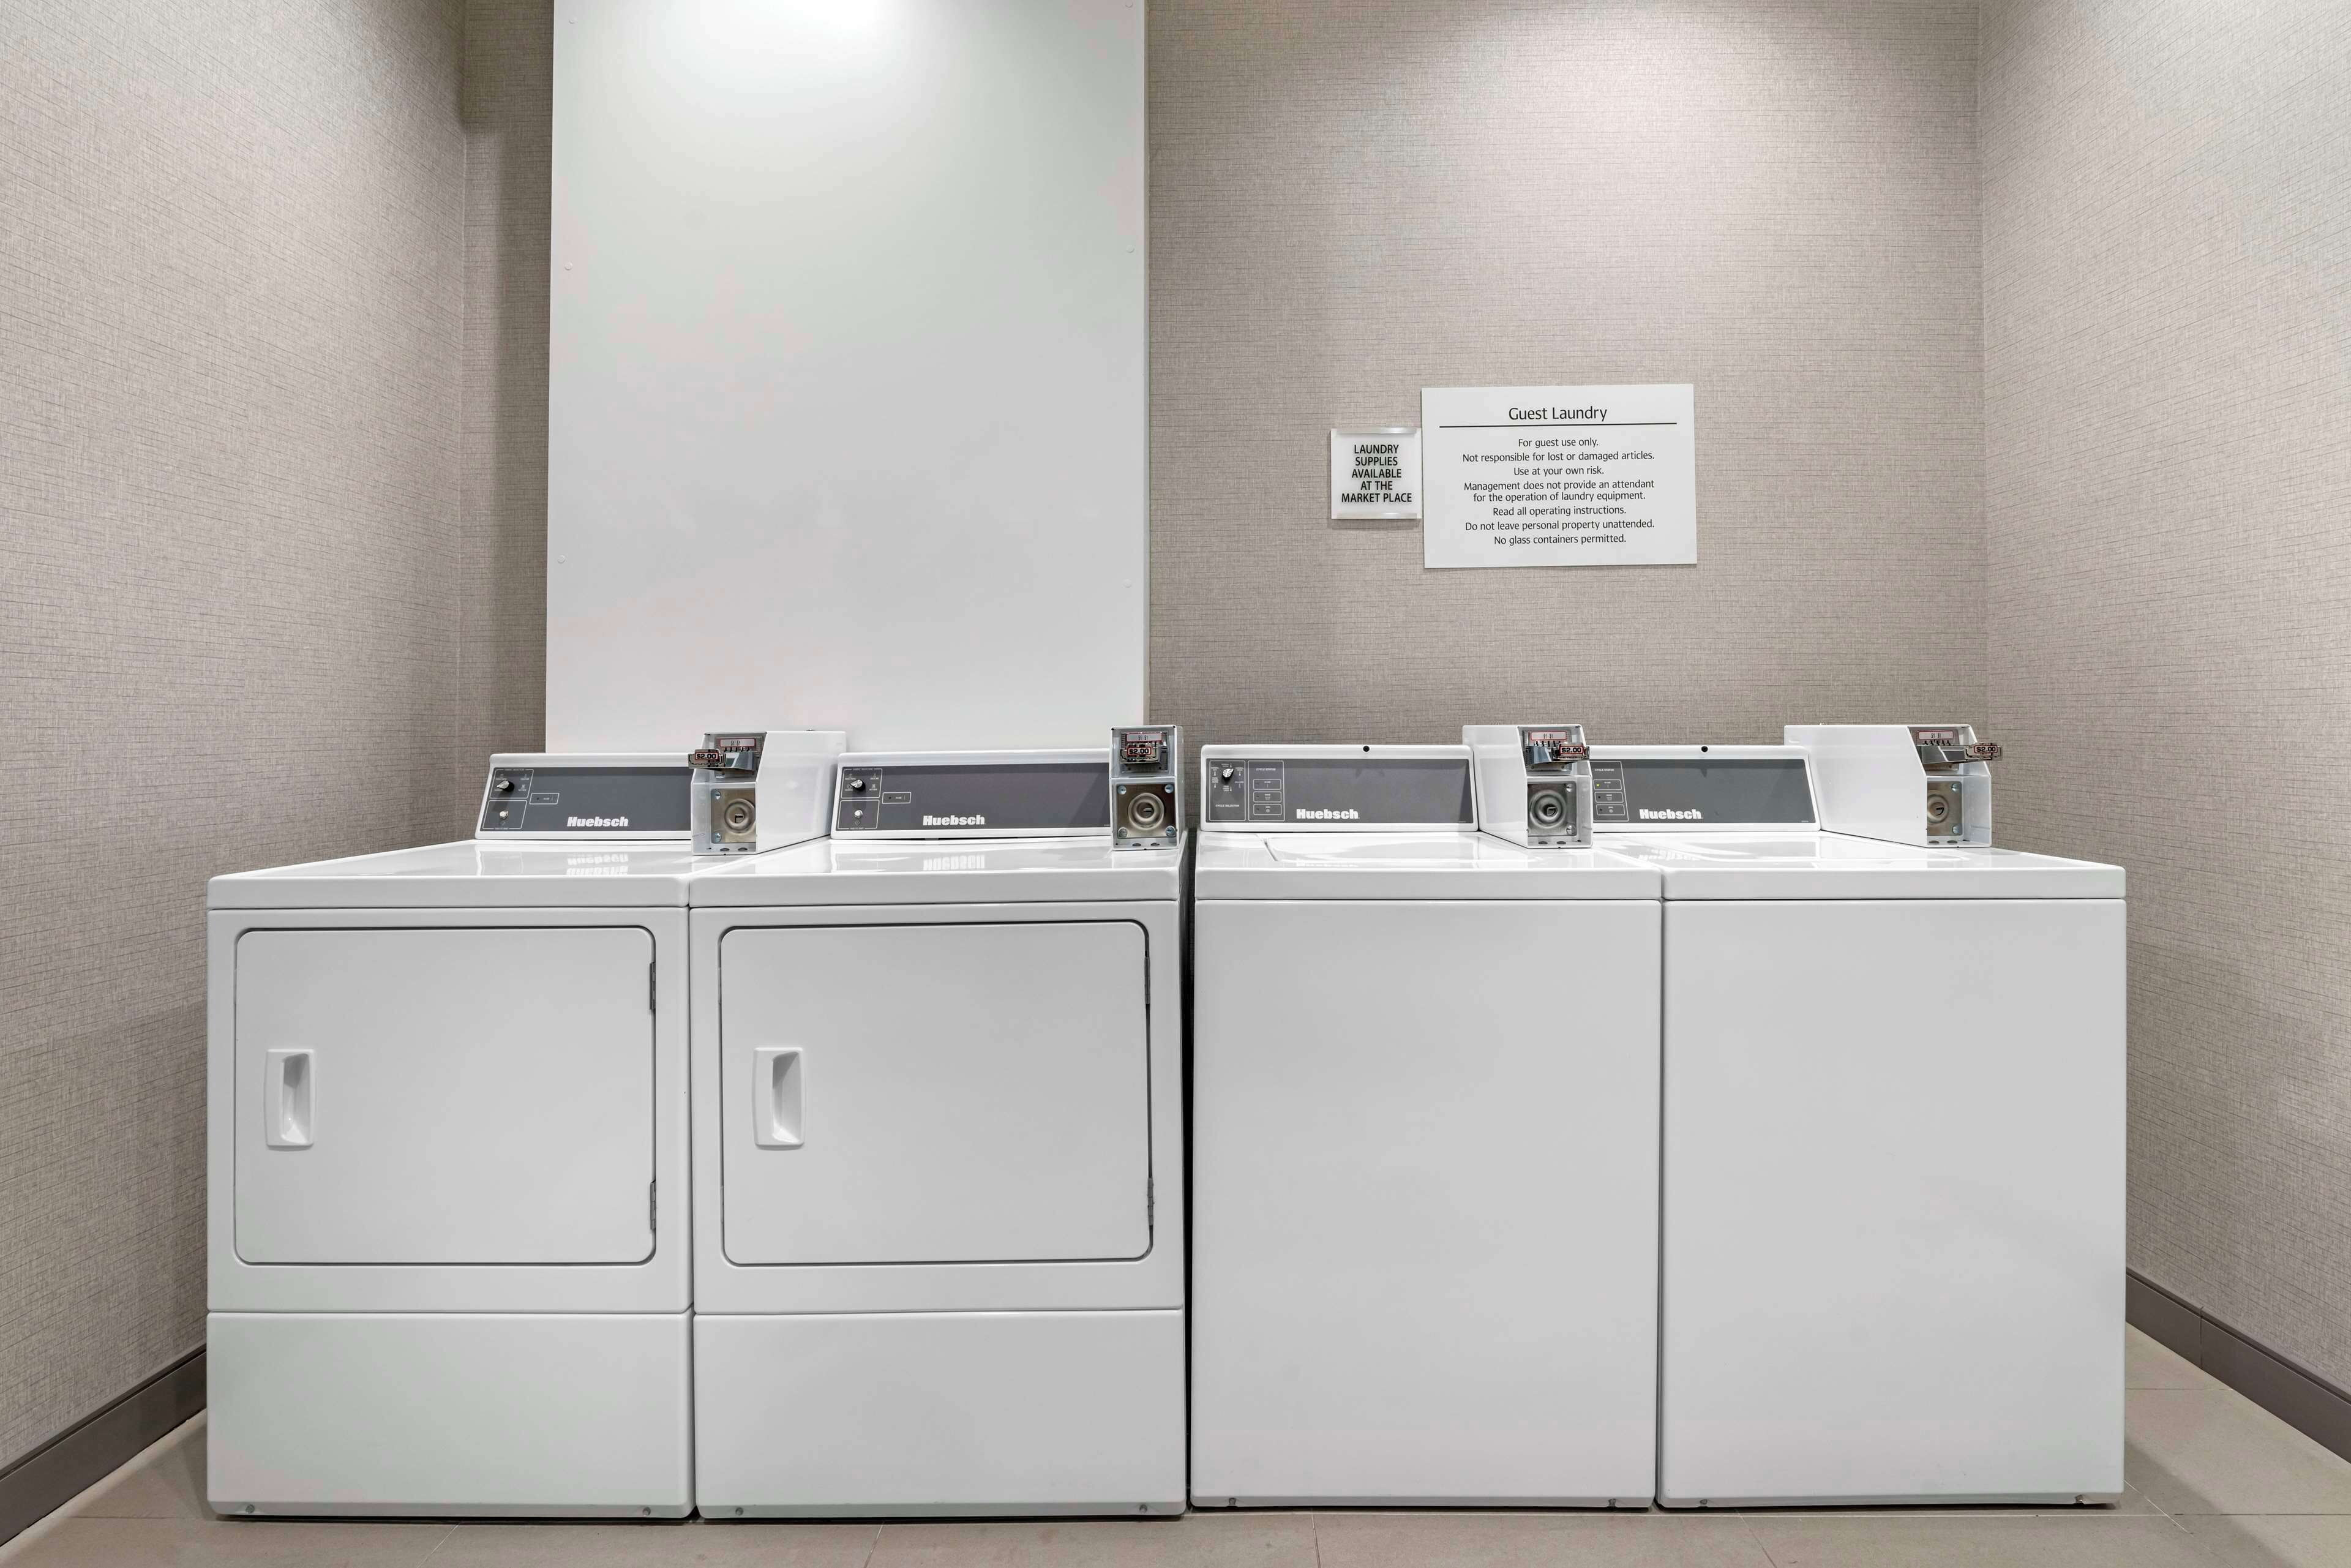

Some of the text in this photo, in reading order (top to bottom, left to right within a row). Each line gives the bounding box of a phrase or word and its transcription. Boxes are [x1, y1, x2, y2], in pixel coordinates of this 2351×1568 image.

[1509, 406, 1607, 422] Guest Laundry
[1535, 438, 1559, 449] guest
[1578, 437, 1599, 448] only.
[1354, 444, 1399, 454] LAUNDRY
[1355, 456, 1398, 467] SUPPLIES
[1481, 452, 1529, 463] responsible
[1532, 452, 1545, 461] for
[1548, 452, 1563, 460] lost
[1578, 451, 1618, 462] damaged
[1621, 451, 1654, 460] articles.
[1351, 468, 1401, 479] AVAILABLE
[1514, 467, 1529, 476] Use
[1543, 468, 1563, 477] your
[1587, 466, 1604, 475] risk.
[1360, 481, 1393, 490] AT THE
[1464, 482, 1521, 492] Management
[1523, 481, 1544, 490] does
[1564, 480, 1596, 491] provide
[1612, 479, 1654, 488] attendant
[1341, 493, 1412, 503] MARKET PLACE
[1473, 491, 1645, 503] for the operation of laundry equipment.
[1493, 505, 1626, 517] Read all operating instructions.
[1498, 522, 1520, 530] leave
[1522, 520, 1559, 531] personal
[1562, 521, 1600, 531] property
[1603, 519, 1654, 528] unattended.
[1509, 535, 1531, 546] glass
[1533, 535, 1578, 544] containers
[1581, 534, 1626, 545] permitted.
[1296, 808, 1359, 819] Huebsch
[1639, 809, 1702, 819] Huebsch
[567, 816, 629, 827] Huebsch
[923, 815, 985, 826] Huebsch
